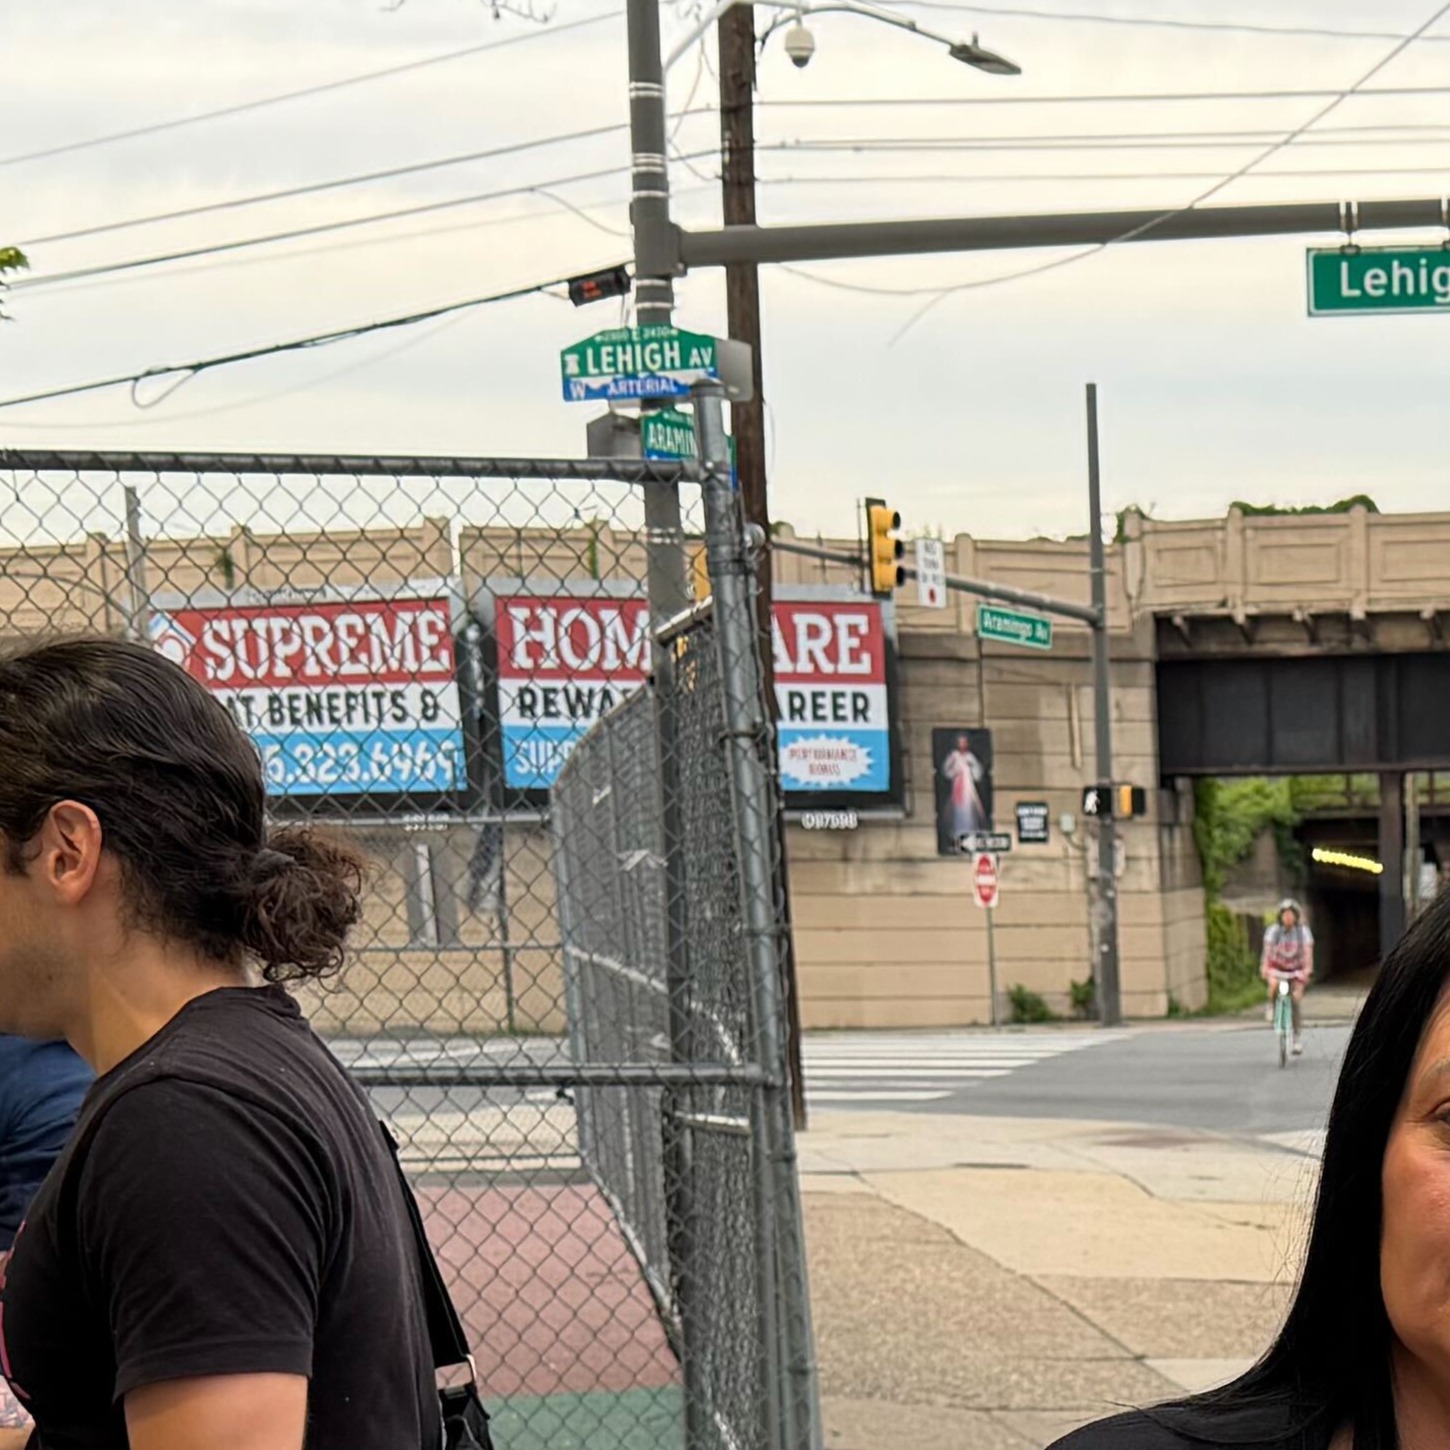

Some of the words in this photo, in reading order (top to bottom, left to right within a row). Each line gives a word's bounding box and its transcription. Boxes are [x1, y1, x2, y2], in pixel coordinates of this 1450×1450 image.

[586, 341, 681, 375] LEHIGH
[689, 347, 713, 367] AV
[607, 378, 677, 395] ARTERIAL
[648, 422, 698, 455] ARAMIN
[203, 610, 451, 680] SUPREME
[508, 606, 651, 671] HOM
[773, 612, 872, 674] ARE
[269, 690, 408, 727] BENEFITS
[421, 690, 440, 721] &
